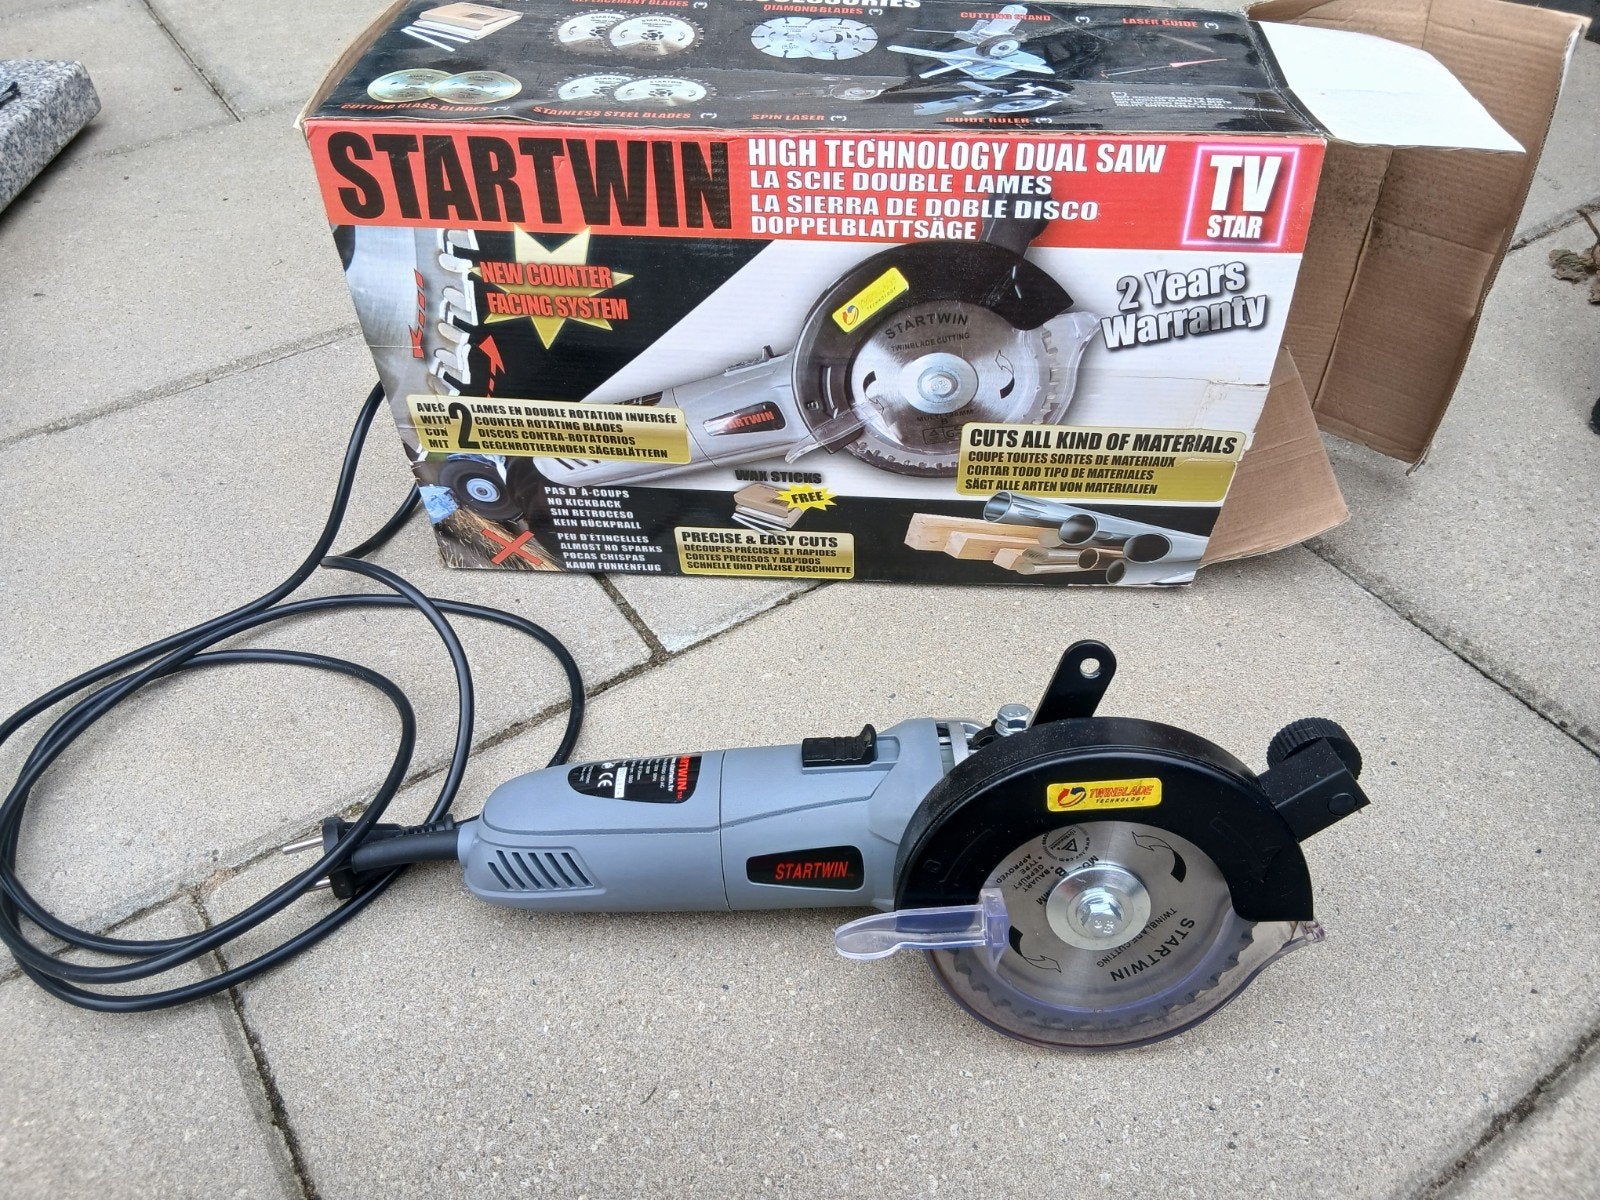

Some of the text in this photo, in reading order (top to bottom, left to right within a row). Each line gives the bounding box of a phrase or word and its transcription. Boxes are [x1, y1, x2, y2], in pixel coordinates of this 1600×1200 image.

[764, 4, 818, 12] DIAMOND
[819, 6, 864, 15] BLADES
[960, 12, 1012, 20] CUTTING
[1122, 18, 1161, 26] LASER
[1162, 19, 1199, 28] GUIDE
[341, 102, 396, 110] CUTTING
[398, 102, 438, 111] GLASS
[440, 104, 487, 112] BLADES
[534, 106, 601, 117] STAINLESS
[604, 110, 640, 118] STEEL
[642, 111, 691, 119] BLADES
[748, 138, 1167, 173] HIGH TECHNOLOGY DUAL SAW
[328, 131, 731, 229] STARTWIN
[750, 170, 1053, 195] LA SCIE DOUBLE LAMES
[1210, 154, 1282, 212] TV
[751, 194, 1098, 221] LA SIERRA DE DOBLE DISCO
[751, 216, 977, 240] DOPPELBLATTSÄGE
[1206, 214, 1263, 239] STAR
[480, 261, 613, 289] NEW COUNTER
[1116, 261, 1248, 311] 2 Years
[486, 292, 629, 320] FACING SYSTEM
[884, 312, 968, 340] STARTWIN
[1100, 295, 1267, 349] Warranty
[416, 402, 446, 413] AVEC
[470, 404, 678, 424] LAMES EN DOUBLE ROTATION INVERSÉE
[420, 415, 451, 425] WITH
[448, 402, 480, 449] 2
[474, 416, 624, 433] COUNTER ROTATING BLADES
[425, 428, 448, 437] CON
[478, 429, 636, 445] DISCOS CONTRA-ROTATORIOS
[428, 439, 449, 449] MIT
[482, 440, 668, 458] GEGENROTIERENDEN SÄGEBLÄTTERN
[970, 428, 1238, 454] CUTS ALL KIND OF MATERIALS
[968, 451, 1176, 468] COUPE TOUTES SORTES DE MATERIAUX
[734, 470, 822, 484] WAX STICKS
[967, 464, 1154, 481] CORTAR TODO TIPO DE MATERIALES
[544, 486, 566, 496] PAS
[965, 478, 1158, 495] SÄGT ALLE ARTEN VON MATERIALIEN
[547, 498, 621, 508] NO KICKBACK
[791, 491, 824, 504] FREE
[550, 508, 634, 519] SIN RETROCESO
[553, 518, 642, 529] KEIN RÜCKPRALL
[557, 532, 577, 541] PEU
[682, 531, 838, 548] PRECISE & EASY CUTS
[560, 542, 601, 551] ALMOST
[622, 544, 663, 553] SPARKS
[684, 544, 732, 554] DÉCOUPES
[735, 545, 780, 555] PRÉCISES
[796, 548, 837, 557] RAPIDES
[562, 552, 646, 562] POCAS CHISPAS
[686, 553, 721, 561] CORTES
[724, 554, 770, 563] PRECISOS
[780, 556, 821, 565] RAPIDOS
[566, 561, 662, 572] KAUM FUNKENFLUG
[688, 561, 852, 574] SCHNELLE UND PRÄZISE ZUSCHNITTE
[1090, 785, 1154, 799] TWINBLADE
[1096, 796, 1146, 804] TECHNOLOGY
[775, 861, 849, 880] STARTWIN
[996, 854, 1031, 884] APPROVED
[1020, 860, 1039, 875] TYPE
[1055, 866, 1067, 877] B
[1013, 864, 1044, 890] GEPRÜFT
[1024, 868, 1051, 893] BAUART
[1110, 918, 1195, 981] STARTWIN
